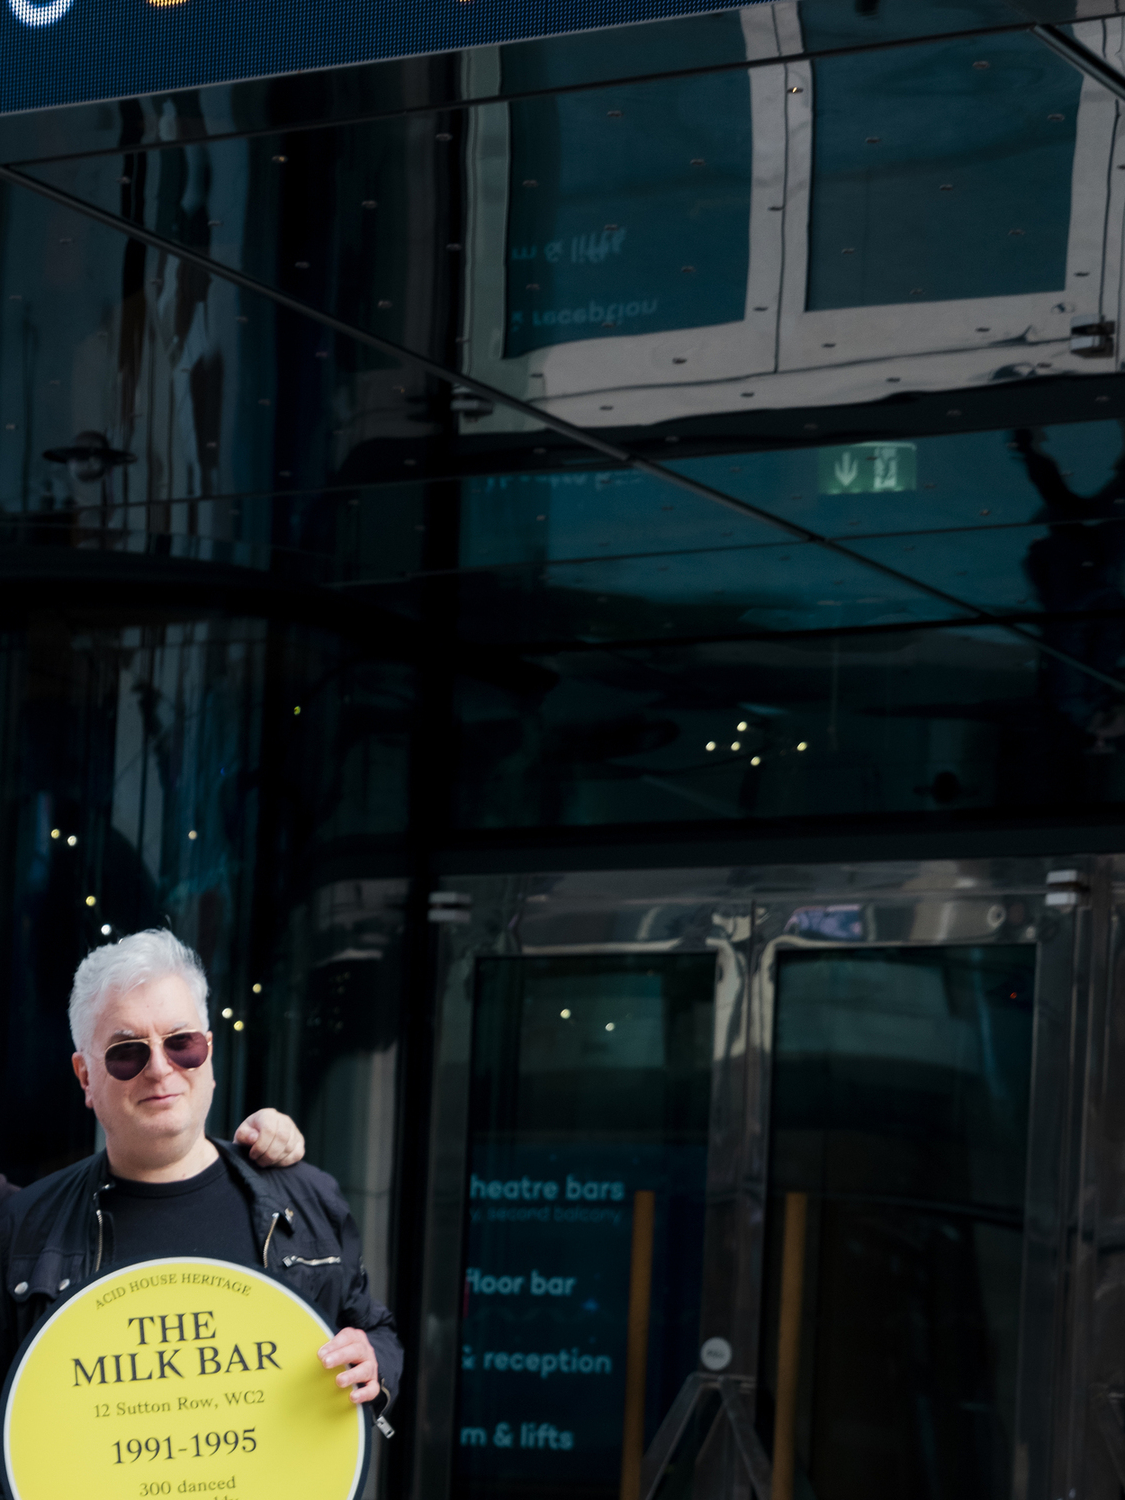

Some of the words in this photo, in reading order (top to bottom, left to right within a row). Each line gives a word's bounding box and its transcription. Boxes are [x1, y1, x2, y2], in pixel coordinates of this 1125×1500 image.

[565, 1173, 625, 1201] bars
[94, 1286, 127, 1310] ACID
[129, 1273, 178, 1294] HOUSE
[181, 1273, 252, 1296] HERITAGE
[530, 1269, 577, 1296] bar
[128, 1310, 216, 1345] THE
[72, 1348, 182, 1387] MILK
[198, 1341, 283, 1376] BAR
[483, 1347, 613, 1379] reception
[94, 1403, 111, 1419] 12
[116, 1400, 171, 1417] Sutton
[177, 1396, 219, 1412] Row,
[224, 1390, 265, 1407] WC2
[112, 1426, 258, 1465] 1991-1995
[493, 1422, 514, 1448] &
[520, 1422, 574, 1451] lifts
[139, 1481, 171, 1496] 300
[177, 1476, 236, 1494] danced
